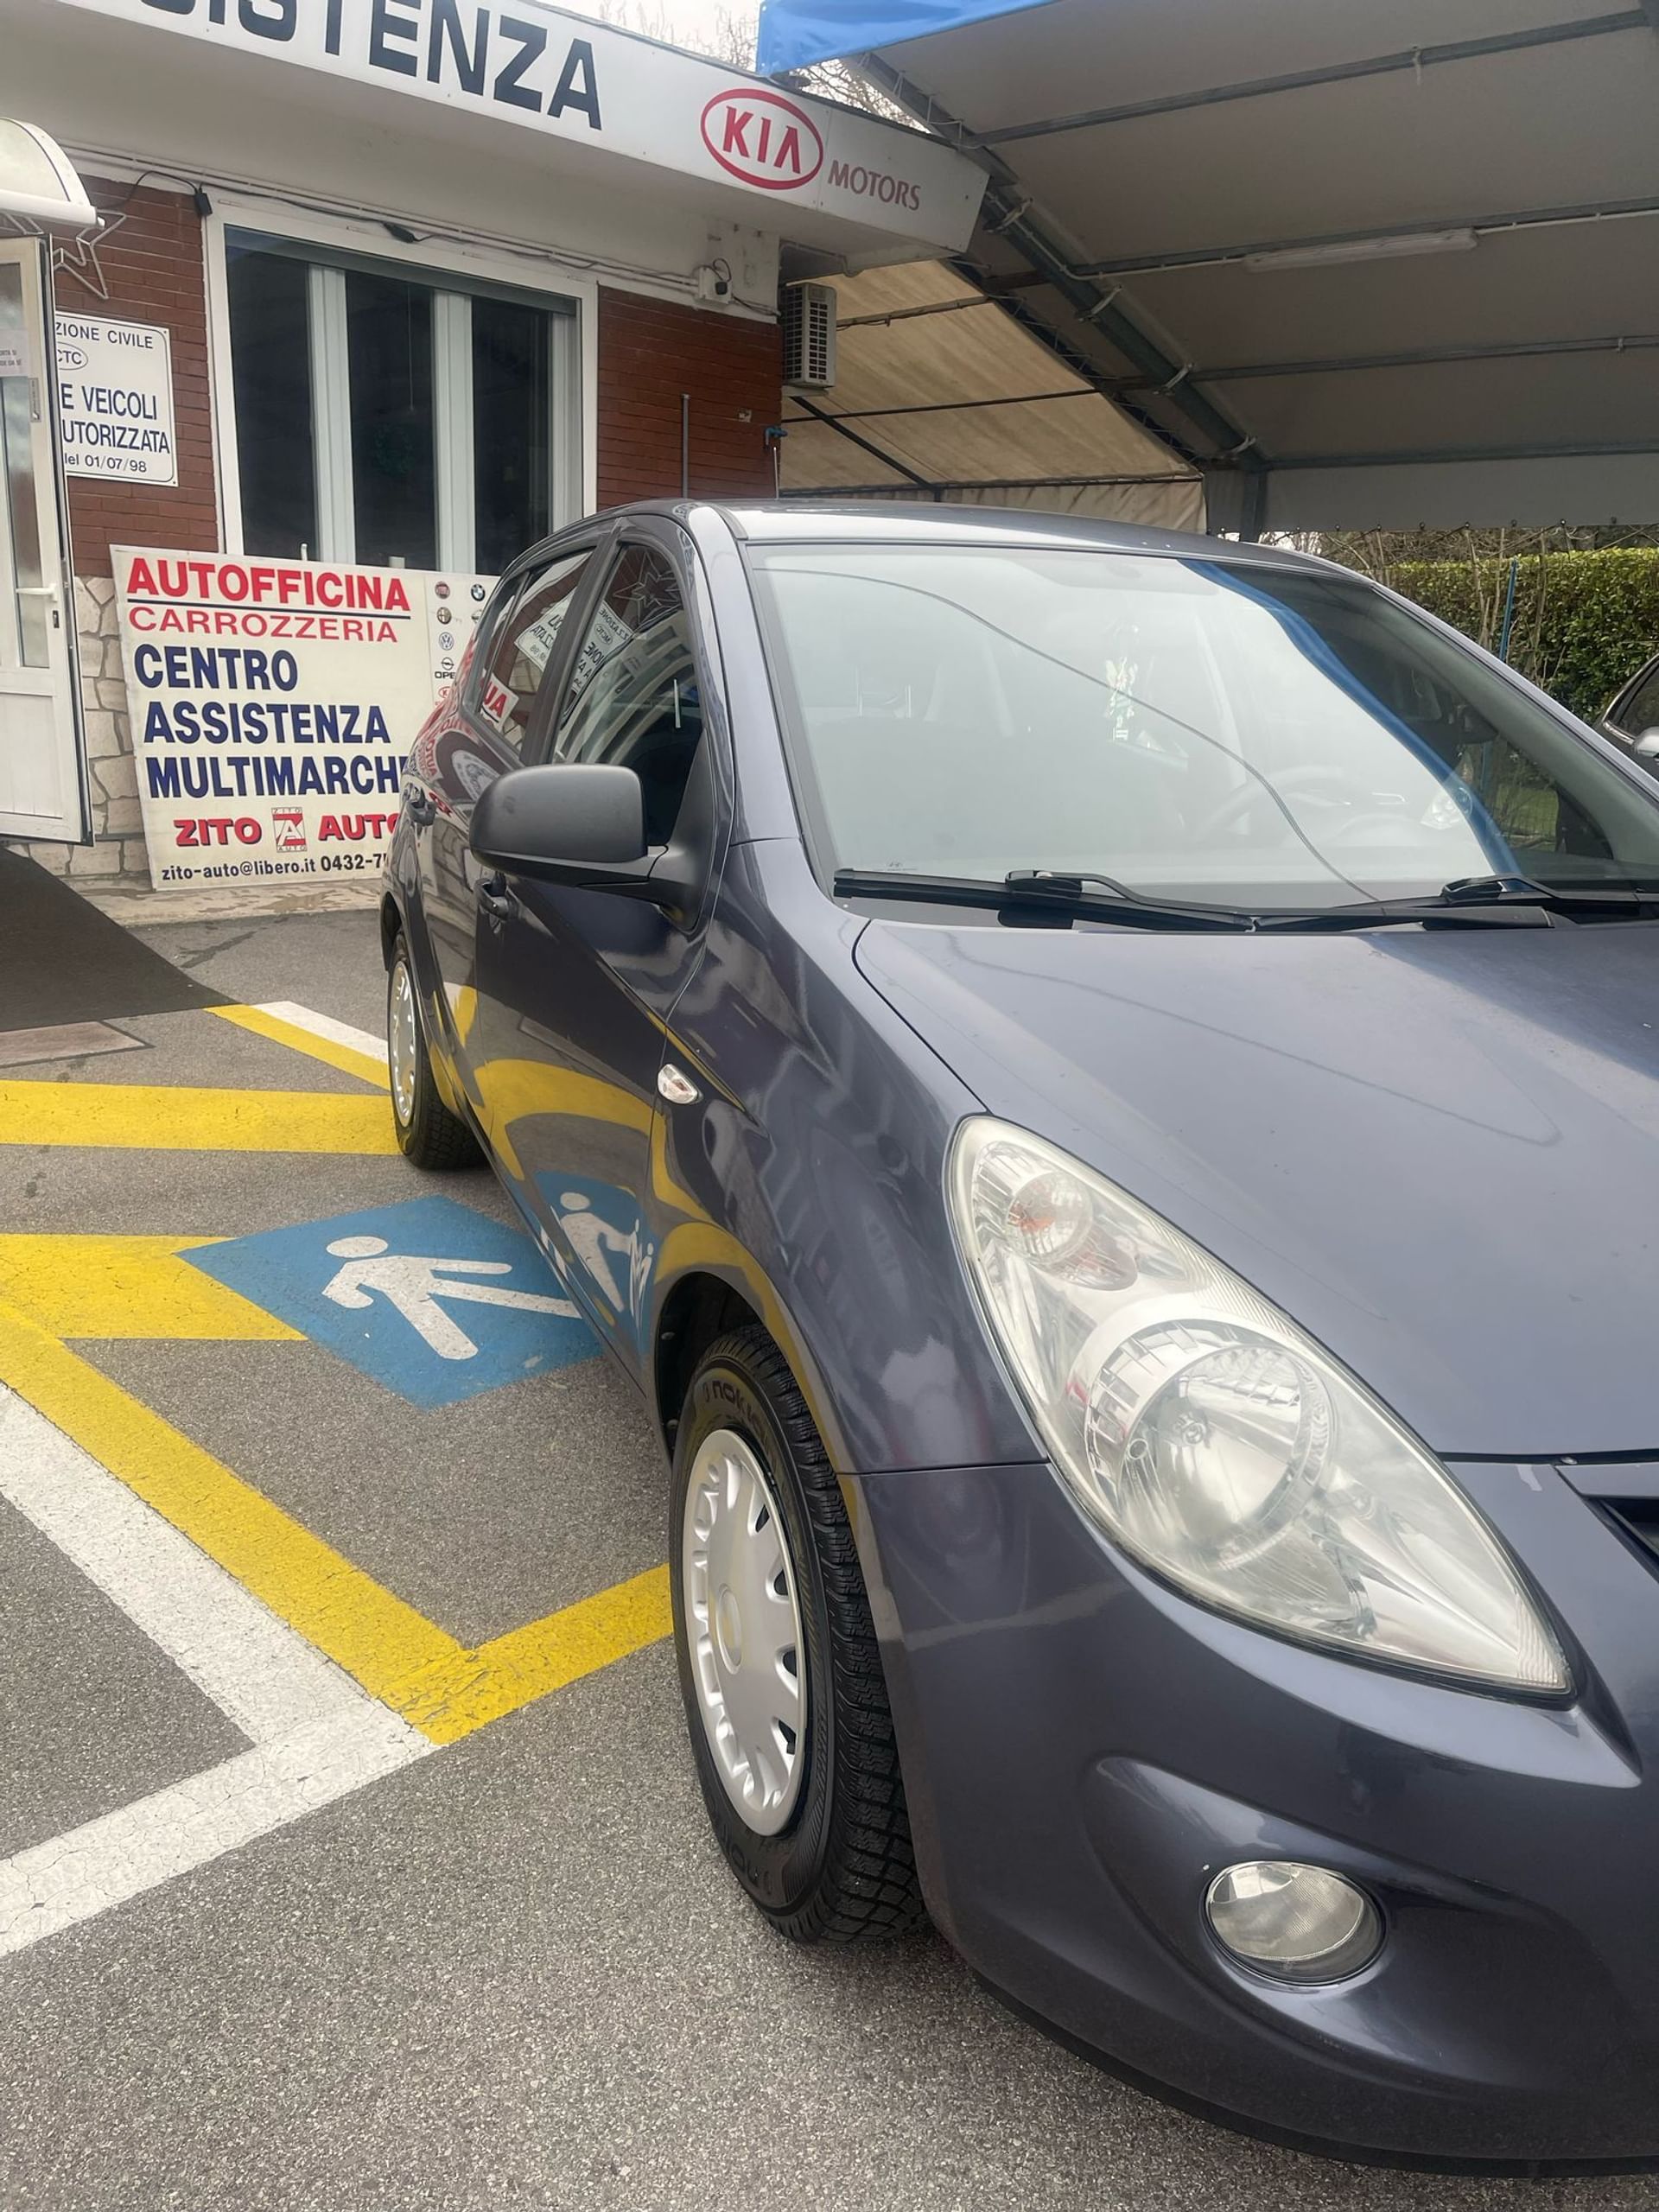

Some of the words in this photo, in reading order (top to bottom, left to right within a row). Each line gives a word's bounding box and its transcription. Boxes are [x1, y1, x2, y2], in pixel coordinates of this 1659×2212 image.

[722, 105, 802, 175] KIA
[827, 159, 921, 212] MOTORS
[107, 330, 154, 349] CIVILE
[60, 383, 74, 410] E
[81, 385, 157, 420] VEICOLI
[62, 419, 170, 454] UTORIZZATA
[85, 454, 147, 474] 01/07/98
[126, 557, 411, 612] AUTOFFICINA
[128, 607, 398, 644] CARROZZERIA
[134, 644, 299, 691] CENTRO
[143, 700, 391, 745] ASSISTENZA
[173, 817, 263, 848] ZITO
[162, 858, 317, 881] zito-auto@libero.it
[321, 852, 387, 872] 0432-7
